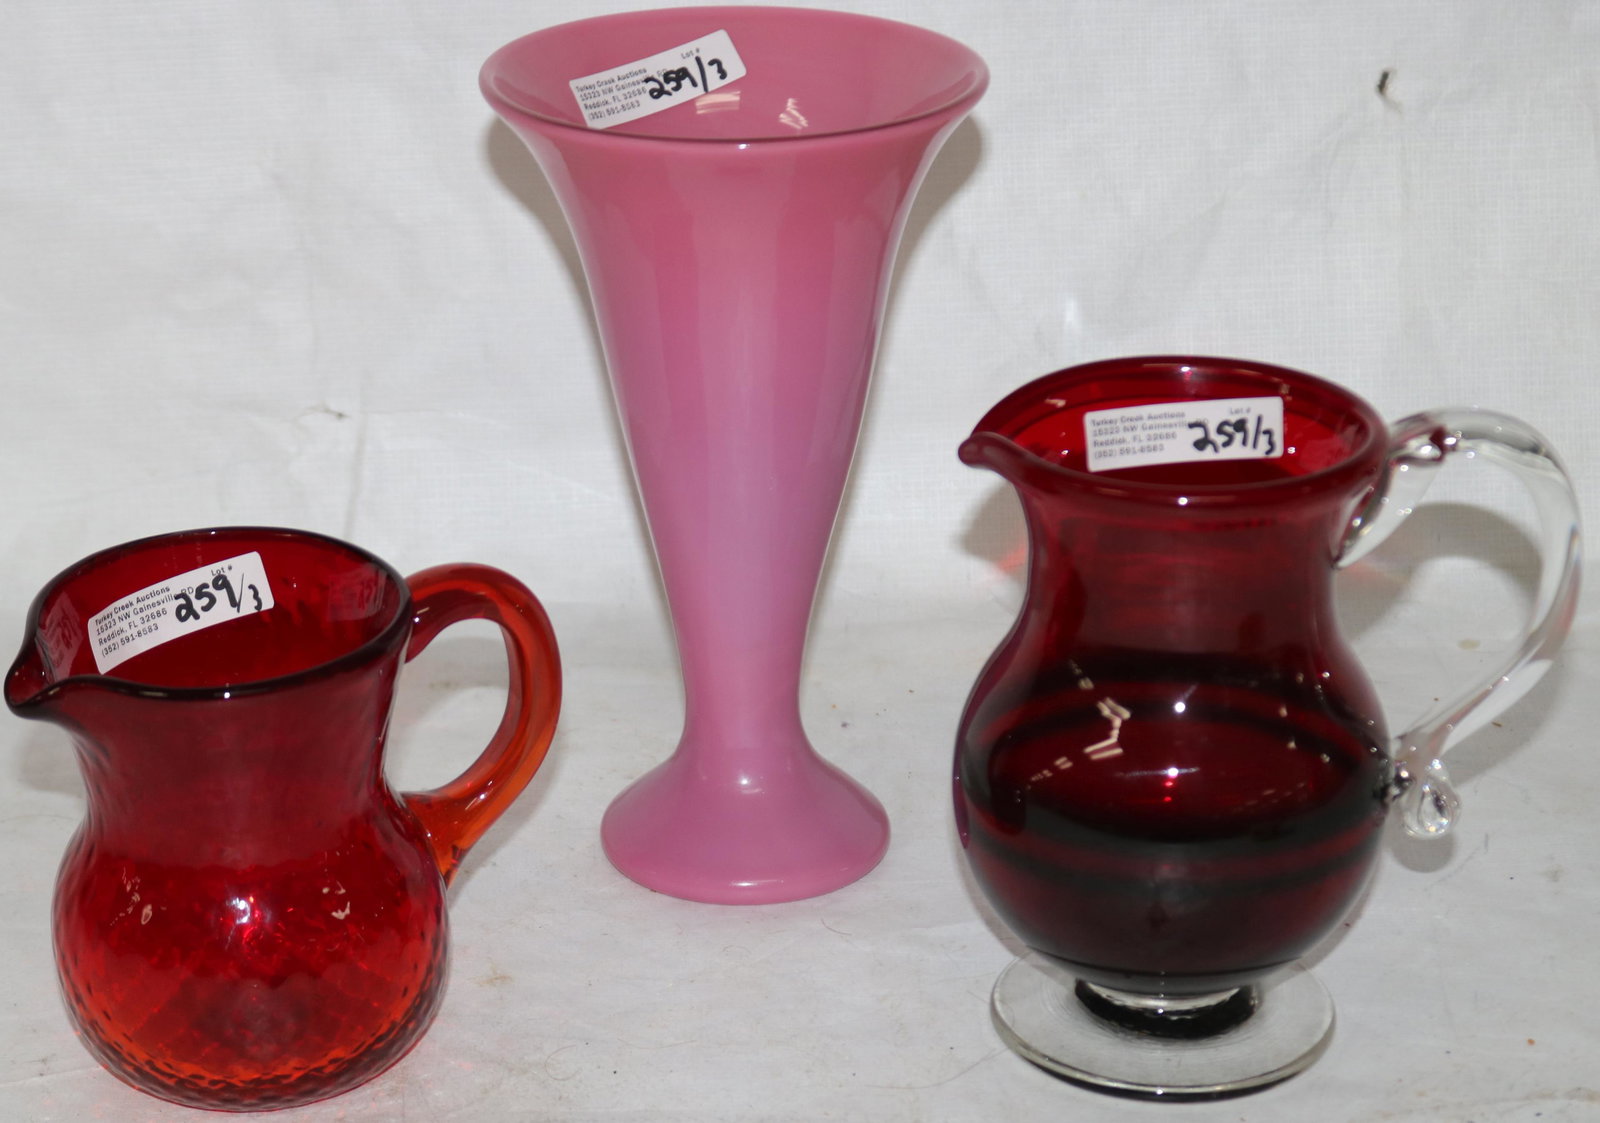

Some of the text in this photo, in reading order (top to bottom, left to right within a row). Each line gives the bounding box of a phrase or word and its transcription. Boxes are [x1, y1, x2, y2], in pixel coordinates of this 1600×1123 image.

[644, 56, 727, 99] 259/3
[1142, 420, 1192, 430] Gainesvill
[1189, 414, 1275, 455] 259/3
[211, 567, 225, 576] Lot
[95, 586, 170, 626] Turkey Creek Auctions
[96, 620, 116, 635] 15323
[118, 613, 131, 622] NW
[133, 595, 180, 615] Gainesvill
[174, 574, 262, 622] 259/3
[129, 620, 138, 630] FL
[140, 608, 167, 624] 32686
[101, 623, 159, 657] (352) 591-8583
